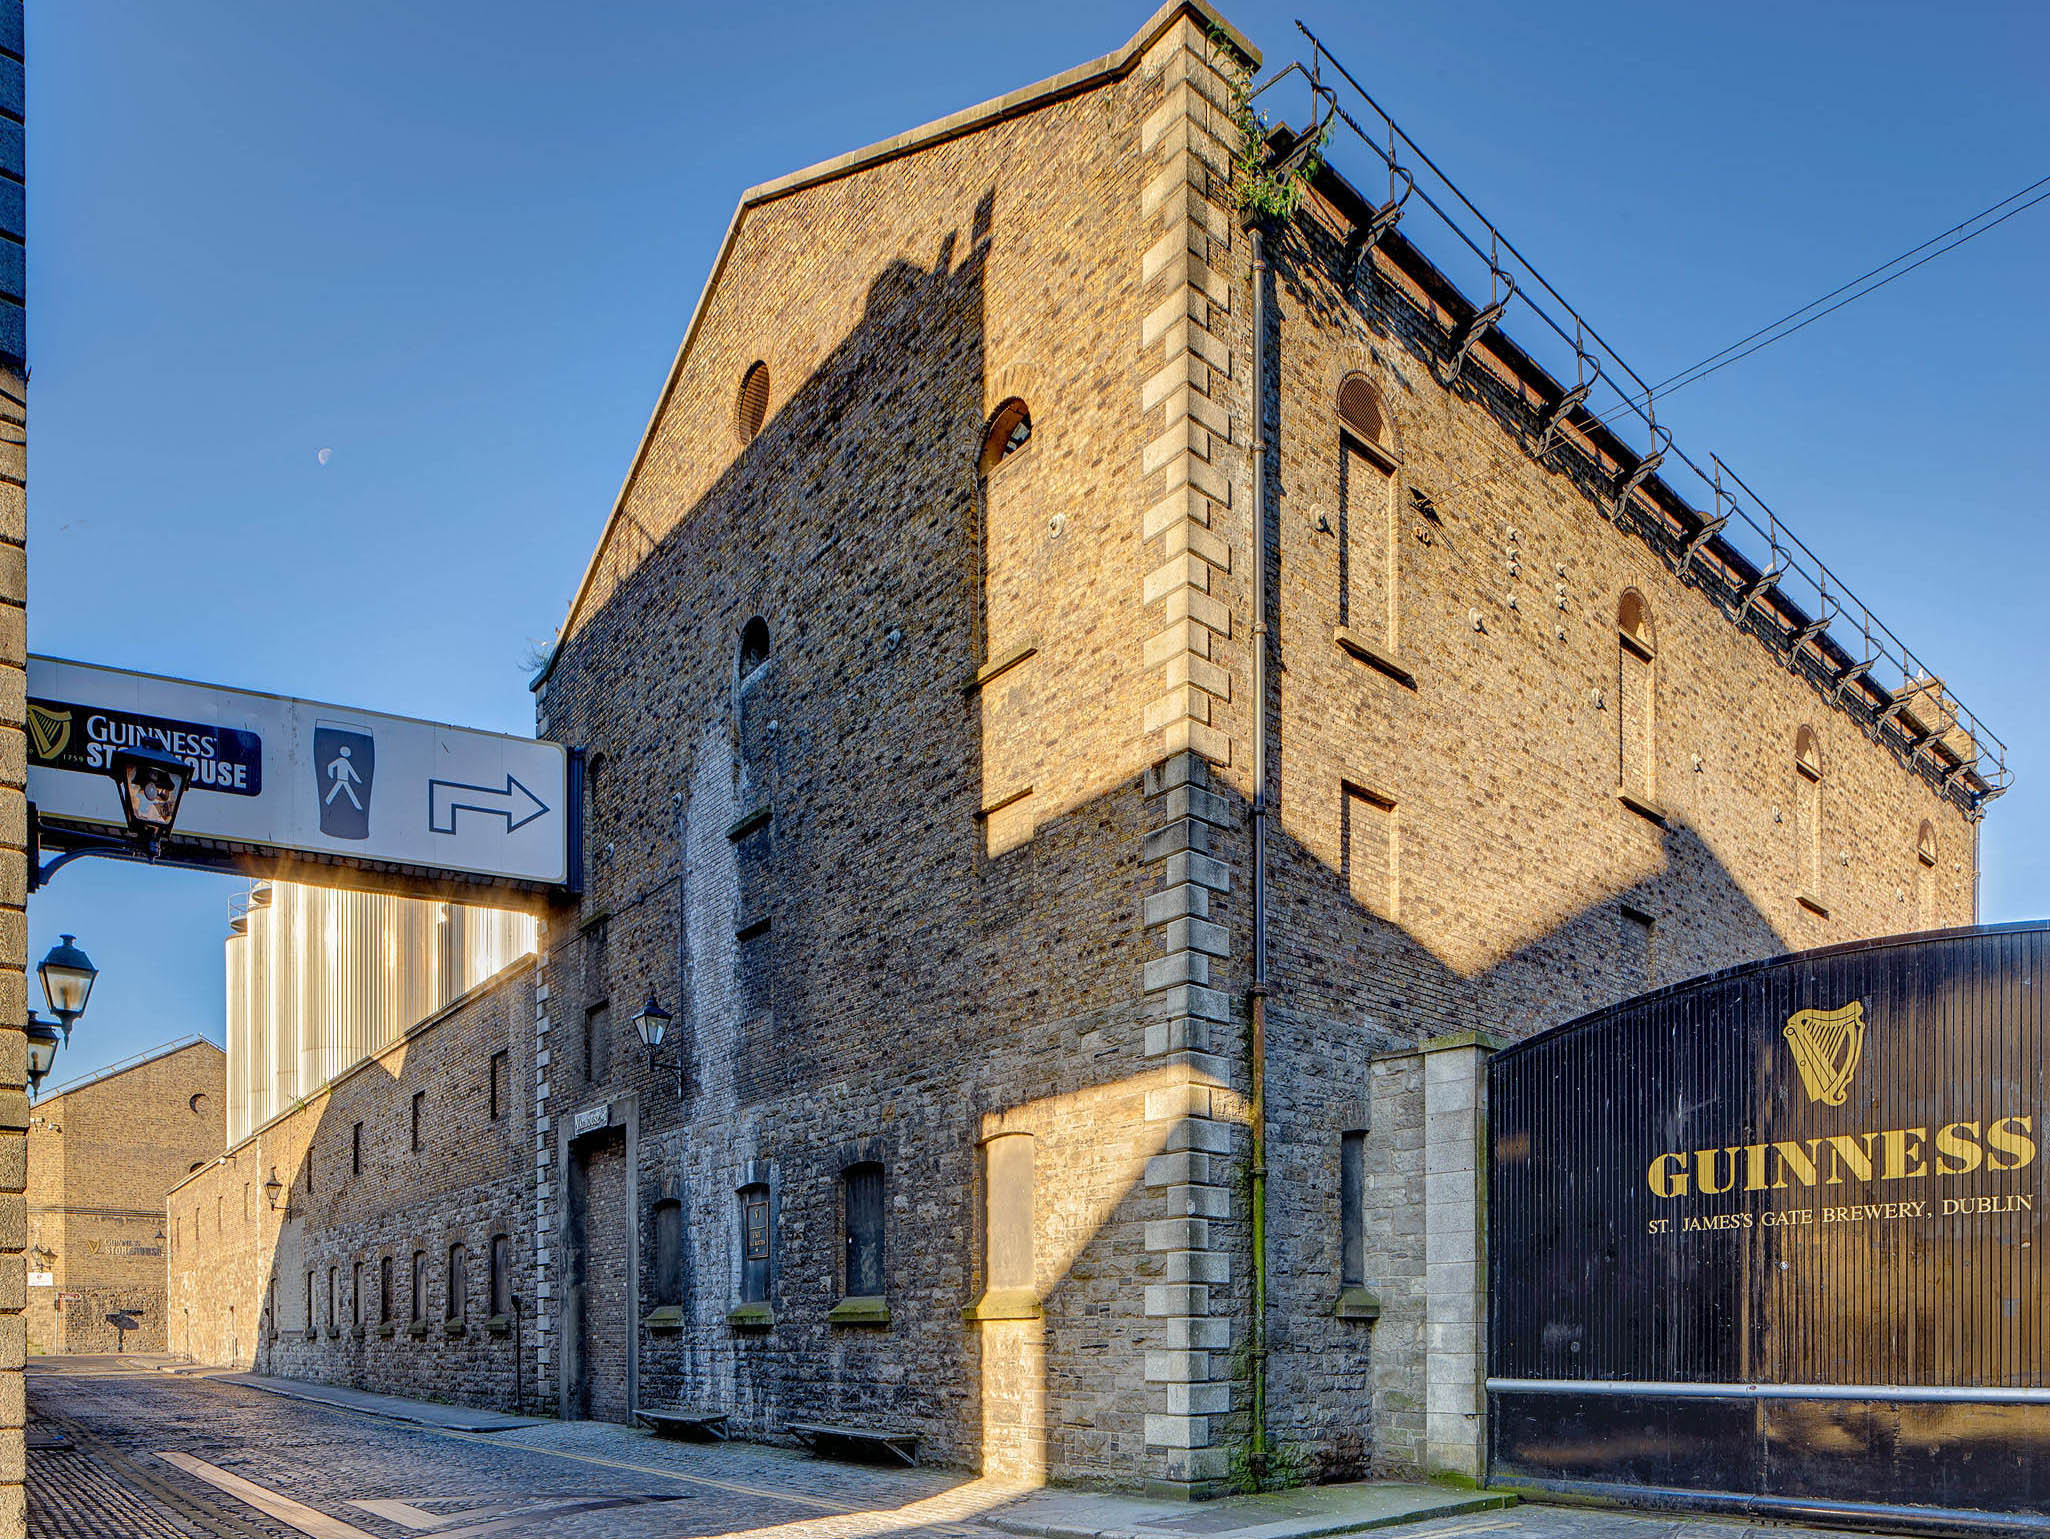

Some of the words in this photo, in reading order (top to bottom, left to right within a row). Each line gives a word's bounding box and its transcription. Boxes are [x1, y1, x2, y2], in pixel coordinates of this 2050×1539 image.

[86, 715, 215, 758] GUINNESS
[86, 742, 247, 789] STOUSE
[1648, 1116, 2036, 1198] GUINNESS
[1649, 1219, 1673, 1234] ST.
[1682, 1212, 1753, 1232] JAMES'S
[1761, 1209, 1813, 1226] GATE
[1822, 1201, 1933, 1223] BREWERY,
[1942, 1194, 2034, 1216] DUBLIN
